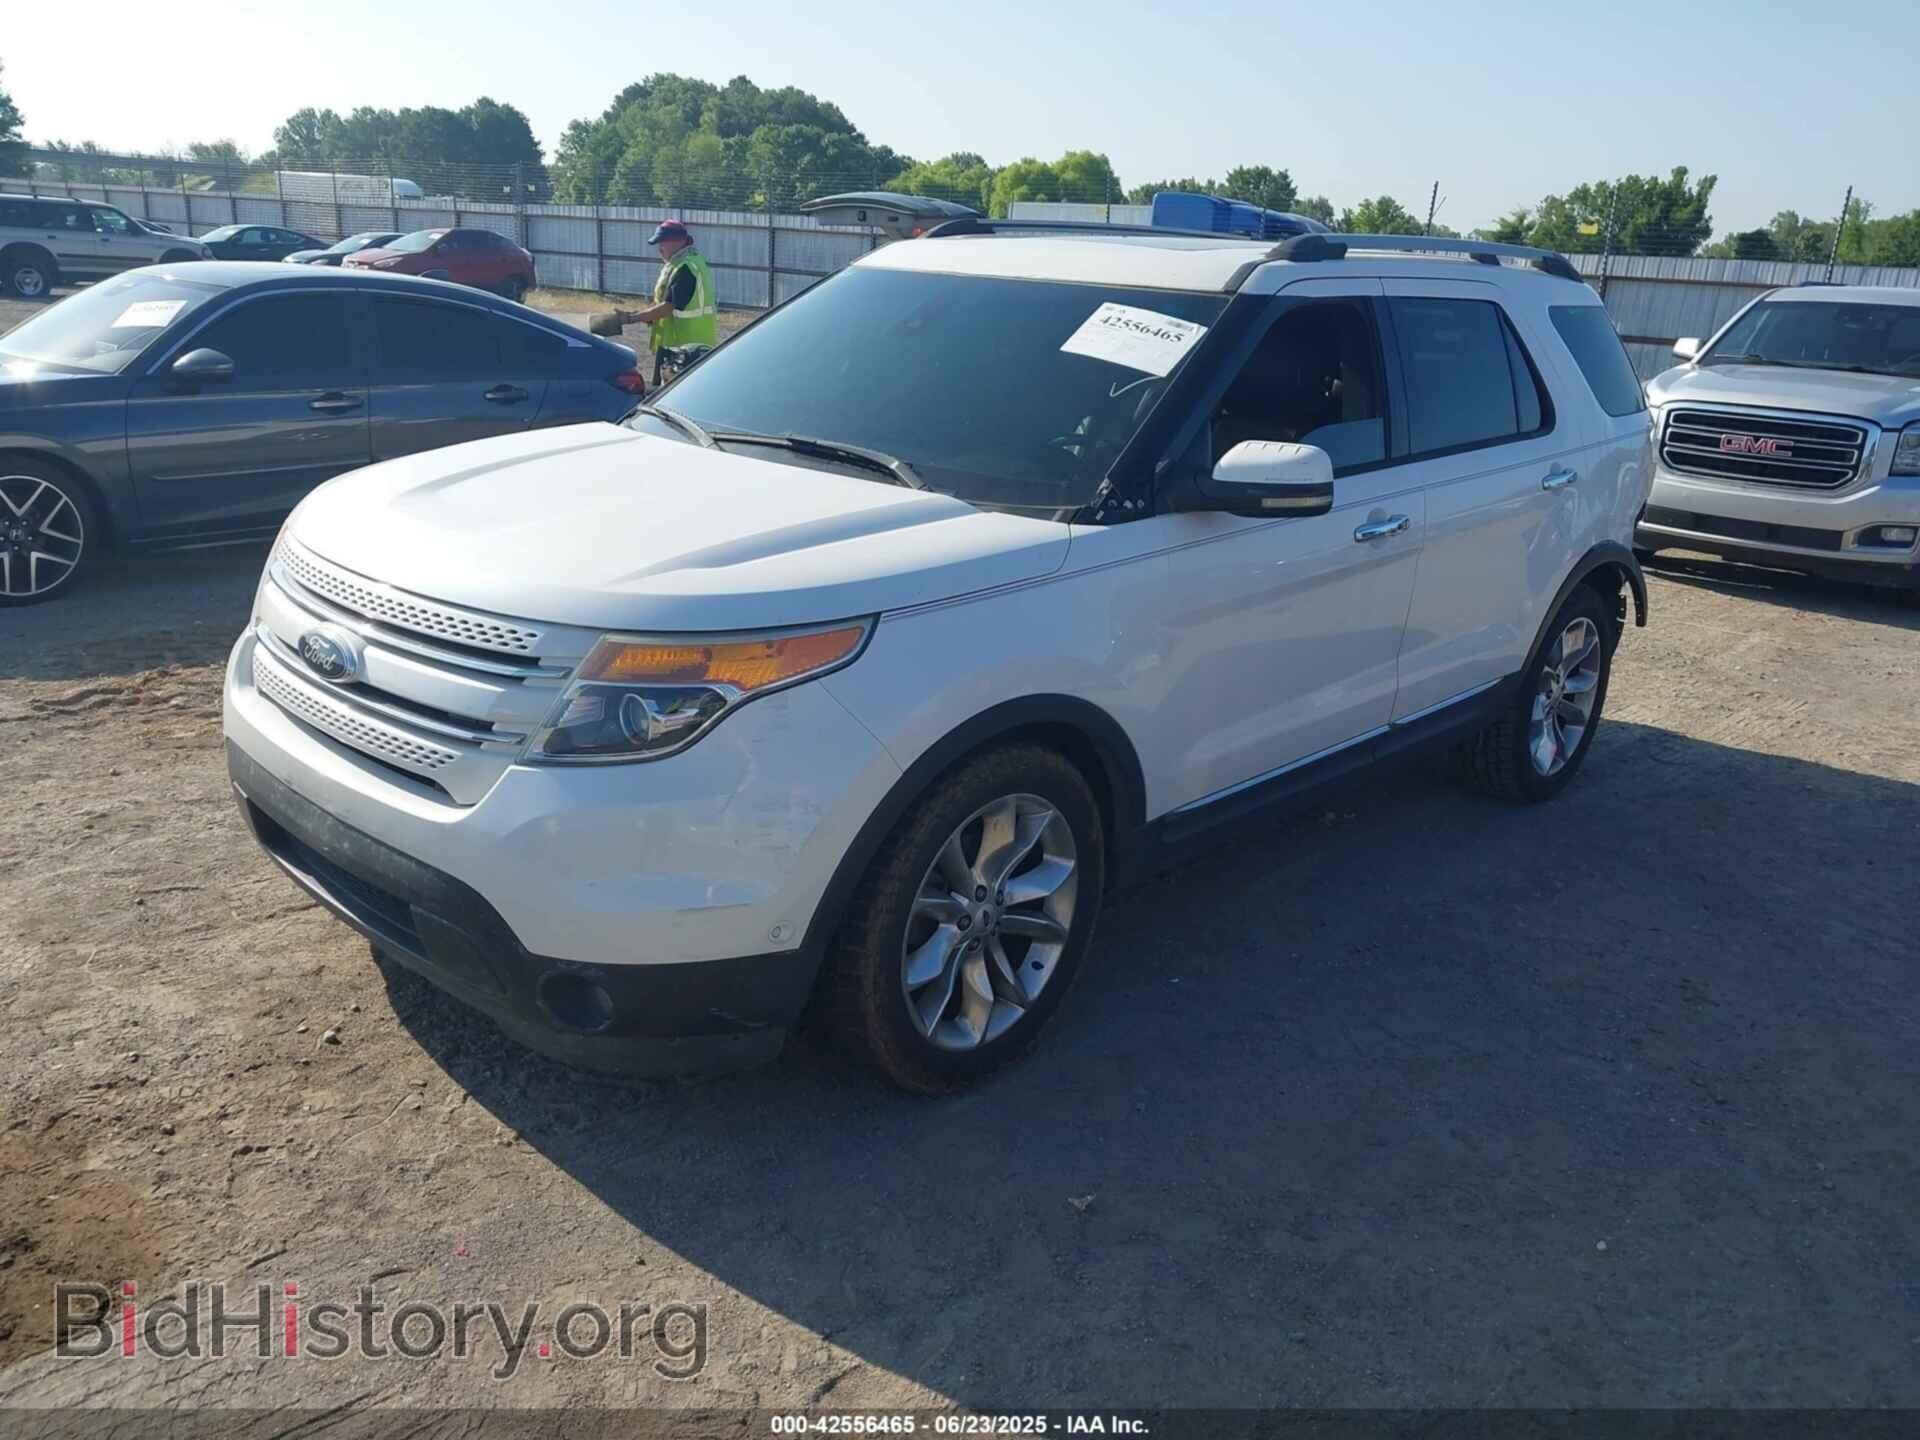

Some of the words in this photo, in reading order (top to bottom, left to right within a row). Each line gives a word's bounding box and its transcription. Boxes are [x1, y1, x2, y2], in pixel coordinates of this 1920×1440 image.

[1099, 315, 1185, 343] 42556465
[1720, 434, 1794, 456] GMC
[304, 635, 337, 671] Ford
